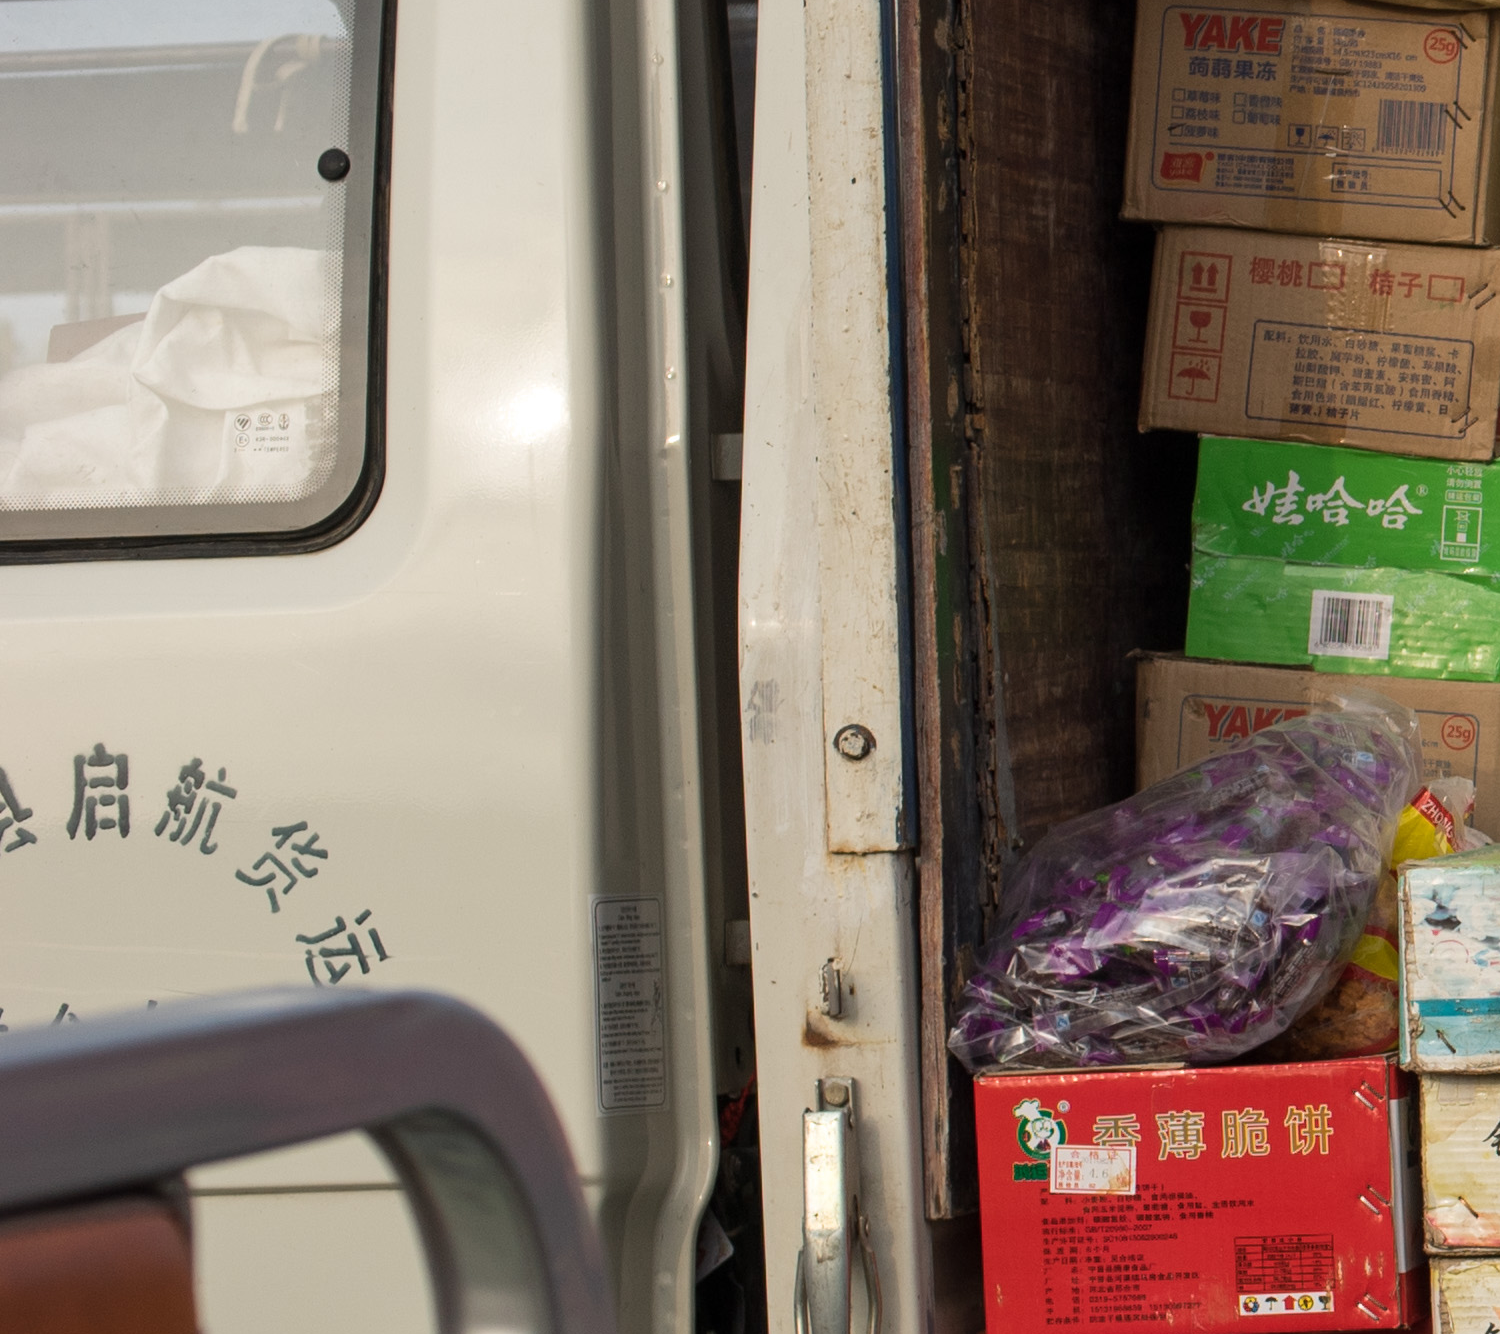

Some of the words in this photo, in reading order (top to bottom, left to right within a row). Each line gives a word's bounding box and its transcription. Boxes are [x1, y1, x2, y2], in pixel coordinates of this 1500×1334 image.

[1179, 13, 1286, 56] YAKE
[1429, 37, 1456, 55] 25g
[1250, 258, 1304, 287] 樱桃
[1243, 470, 1422, 529] 娃哈哈
[1446, 725, 1471, 742] 25g
[1093, 1105, 1334, 1161] 香薄脆饼
